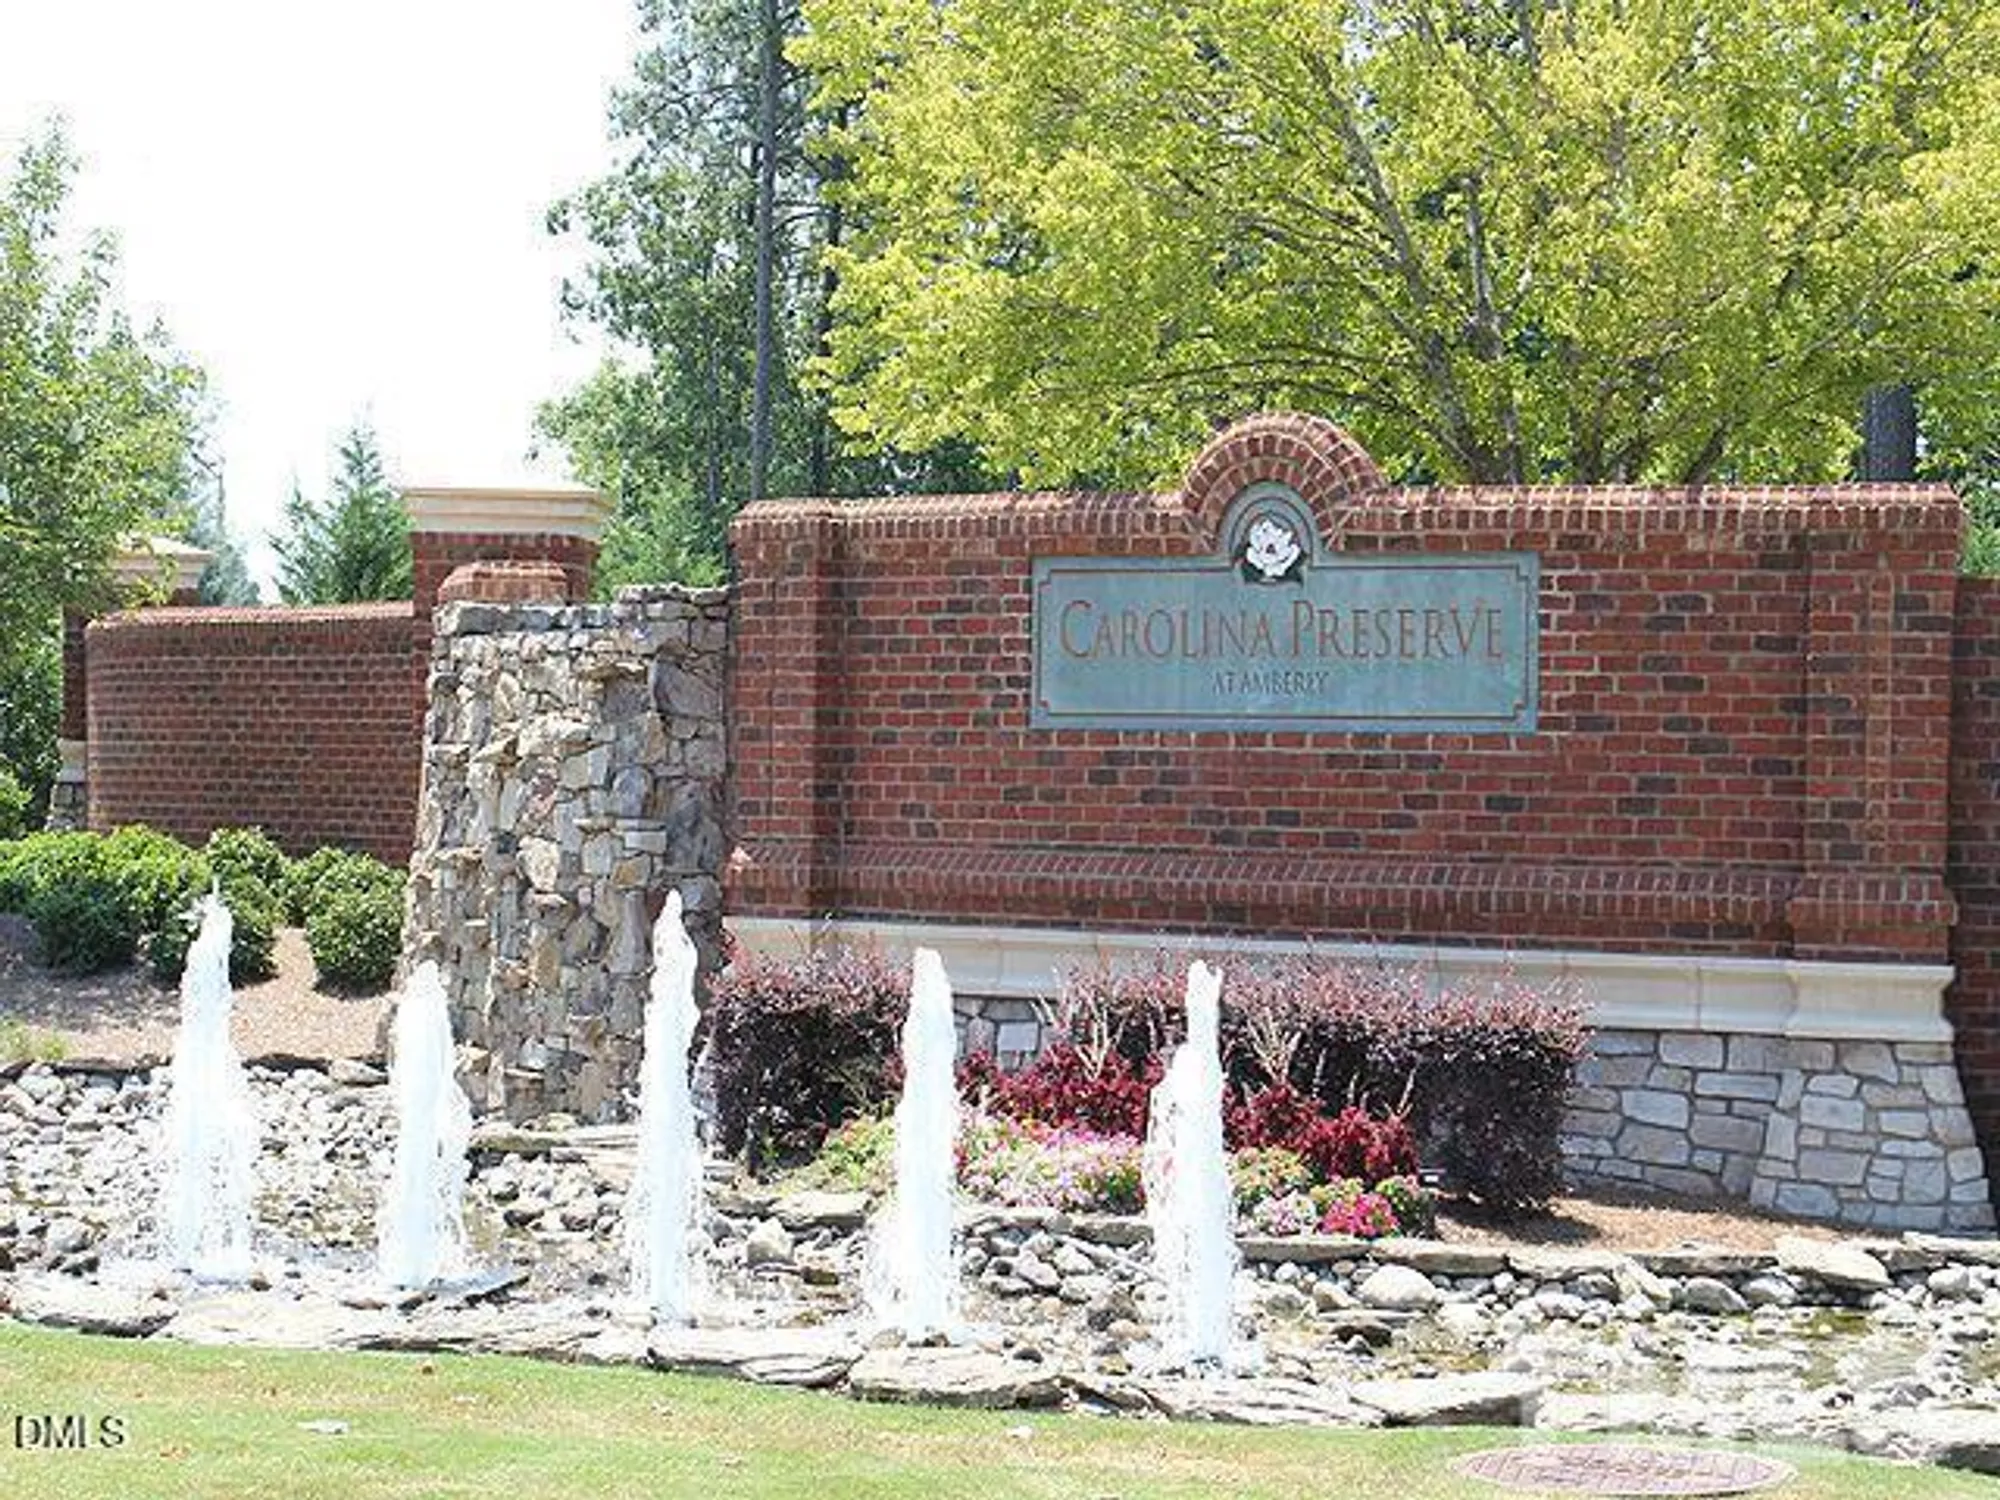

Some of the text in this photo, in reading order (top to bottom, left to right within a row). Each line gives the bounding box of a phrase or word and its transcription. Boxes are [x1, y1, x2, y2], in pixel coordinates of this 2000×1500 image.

[1060, 598, 1504, 659] CAROLINA PRESERVE
[1211, 670, 1330, 695] AT AMBERLY
